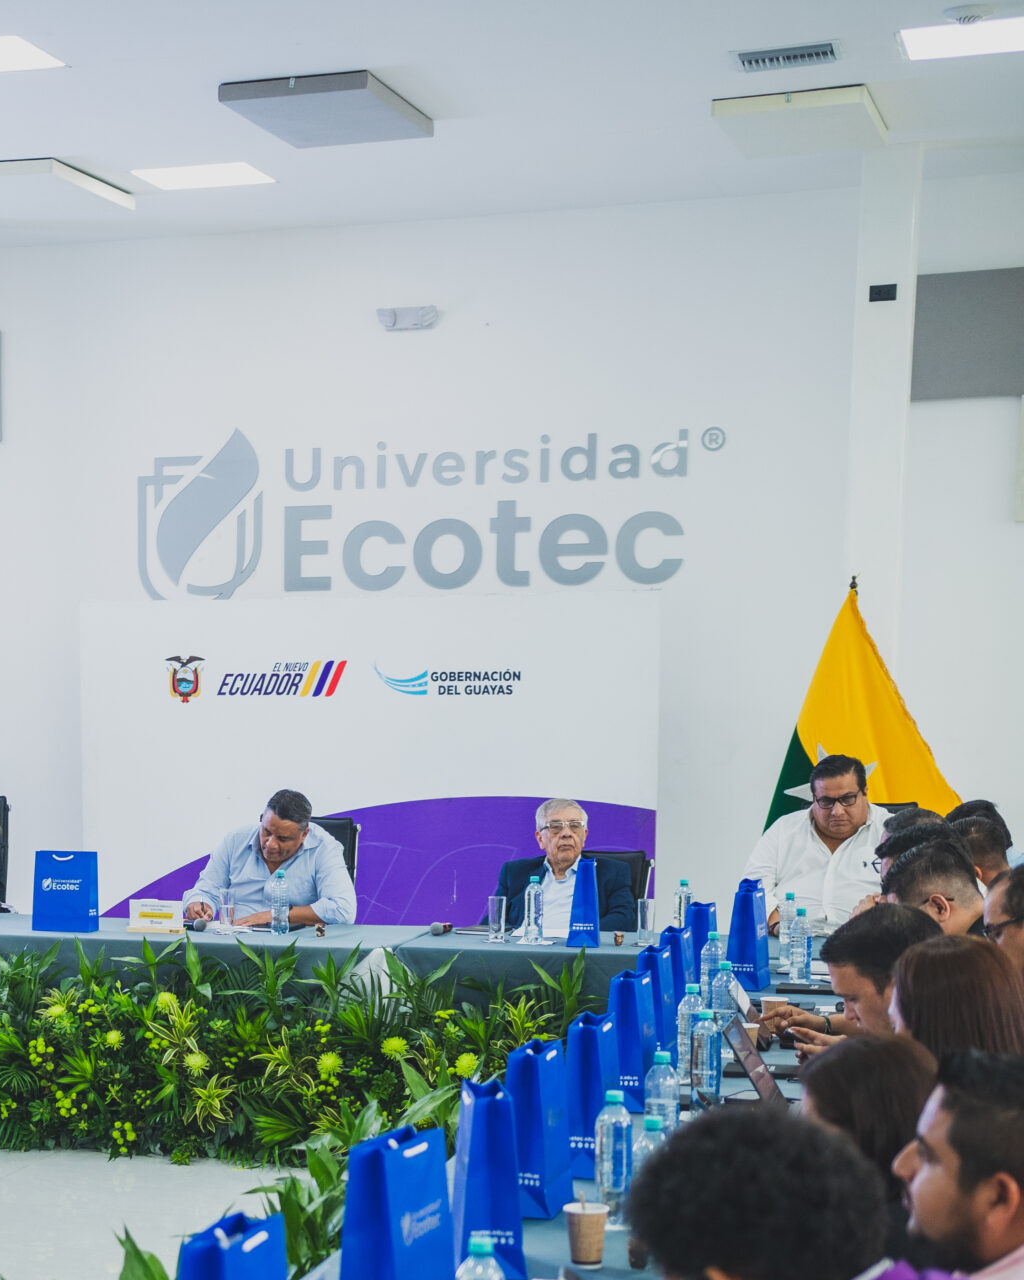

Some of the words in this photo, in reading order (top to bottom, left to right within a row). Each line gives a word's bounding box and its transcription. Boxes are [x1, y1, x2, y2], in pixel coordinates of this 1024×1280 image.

[283, 500, 685, 592] Ecotec
[272, 662, 283, 672] EL
[283, 662, 310, 672] NUEVO
[430, 668, 522, 682] GOBERNACIÓN
[216, 673, 304, 696] ECUADOR
[438, 685, 461, 696] DEL
[464, 685, 514, 696] GUAYAS
